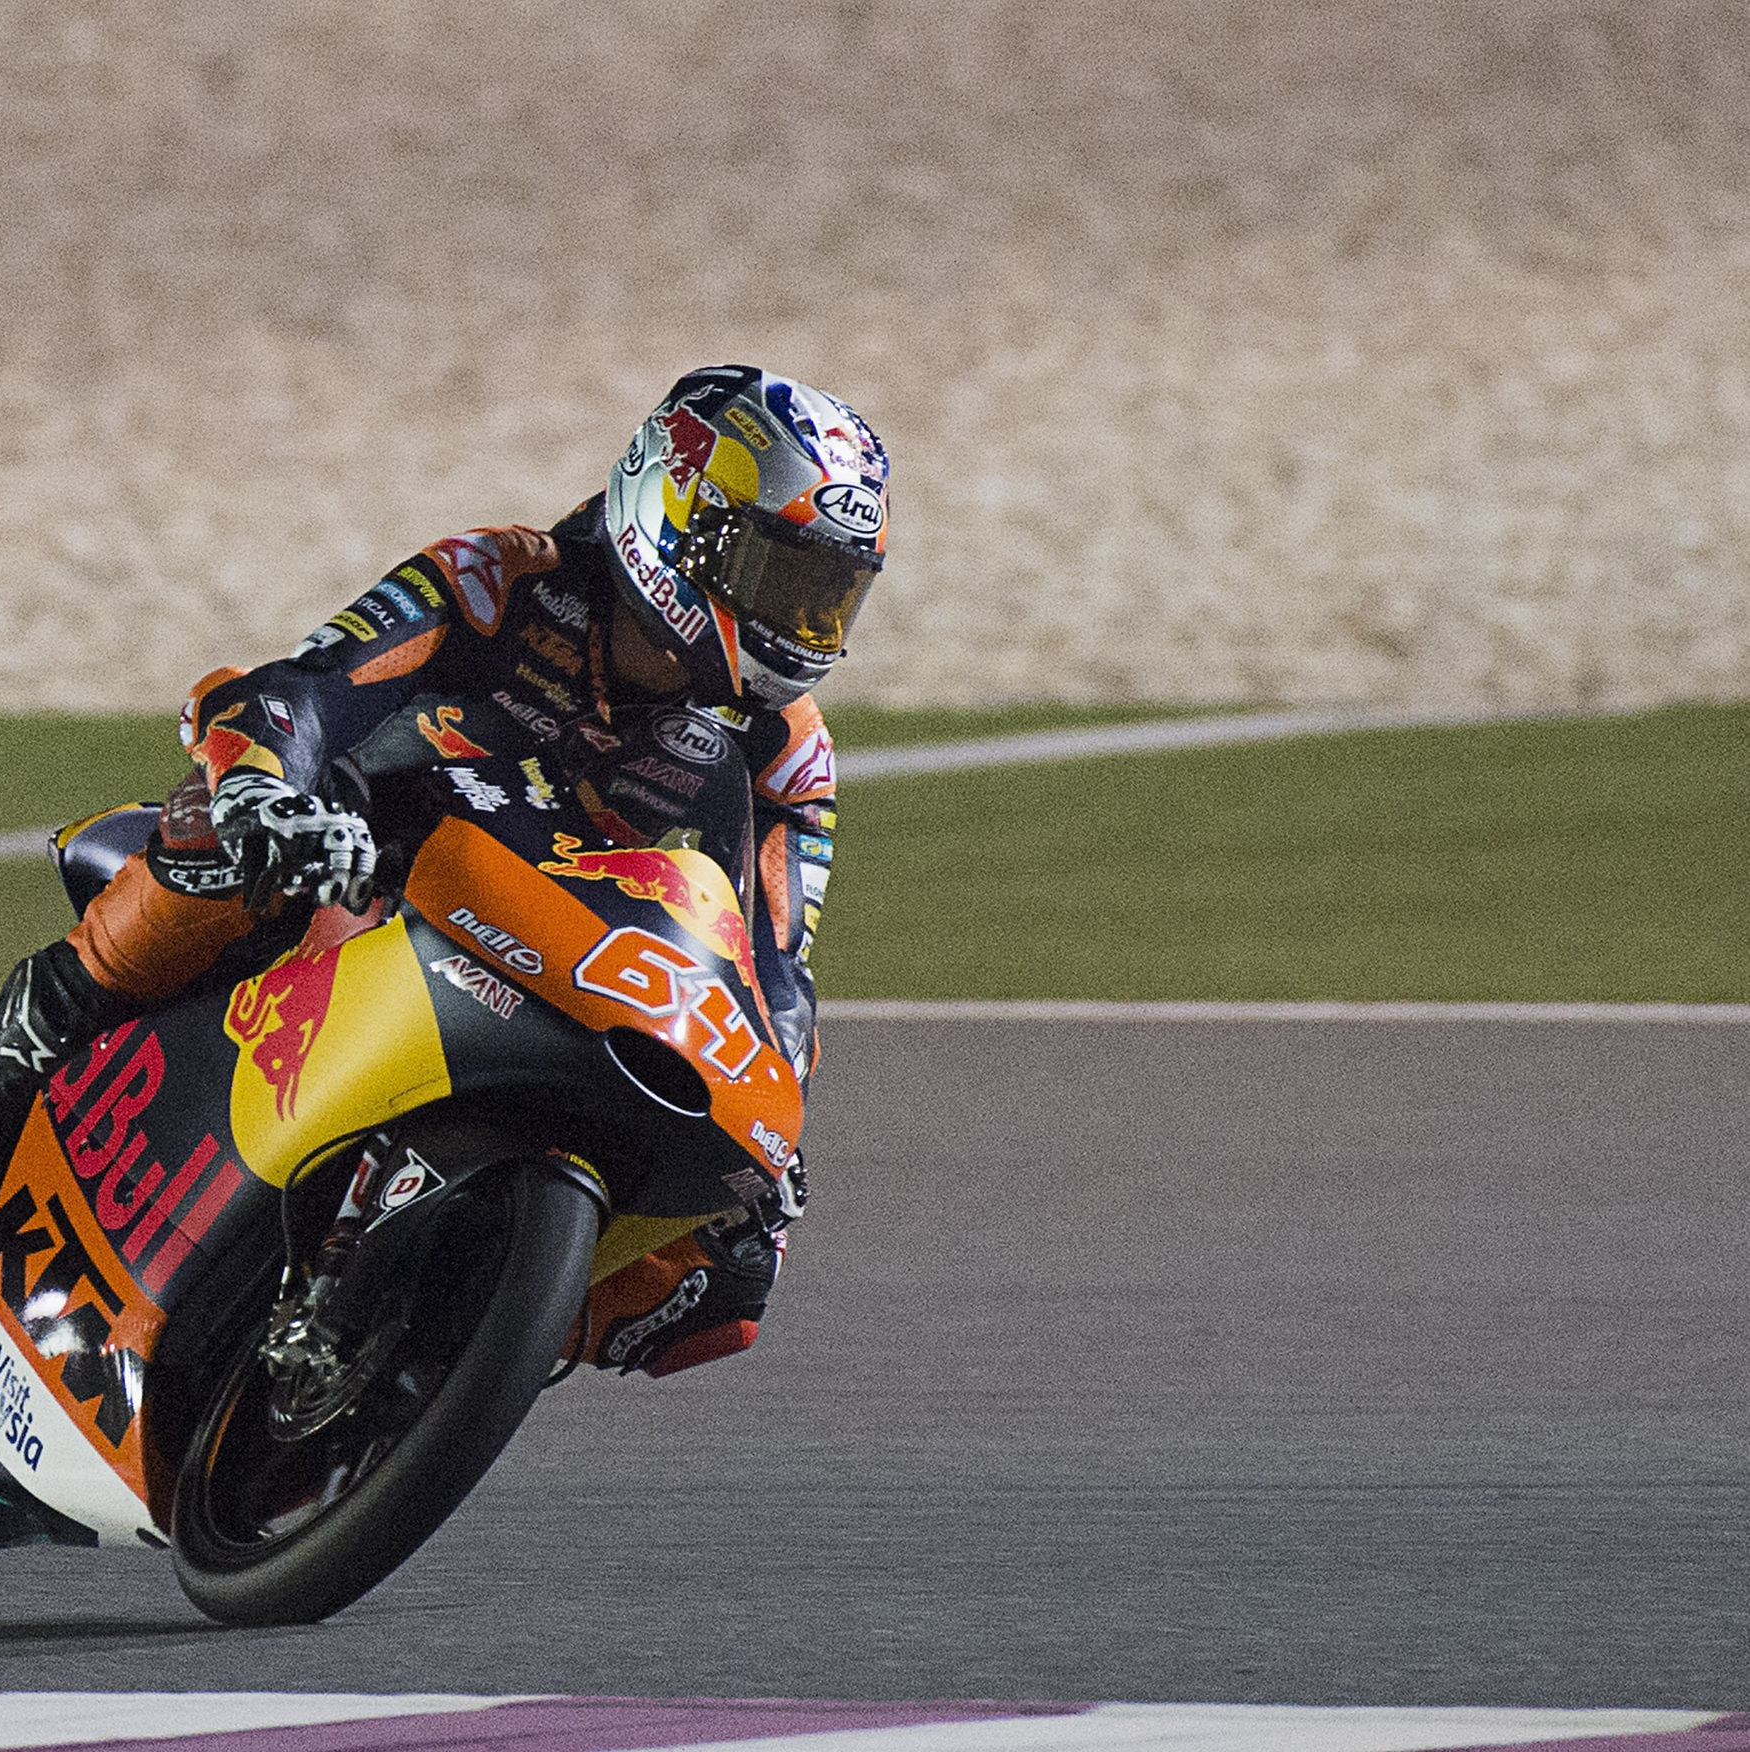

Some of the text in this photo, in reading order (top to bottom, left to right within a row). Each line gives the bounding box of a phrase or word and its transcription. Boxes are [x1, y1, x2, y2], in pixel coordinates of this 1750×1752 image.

[820, 488, 880, 525] Arai
[357, 596, 396, 630] TICAL
[520, 624, 584, 676] KTM
[656, 718, 717, 755] Arai
[429, 955, 525, 1020] AVANT
[571, 926, 763, 1082] 64
